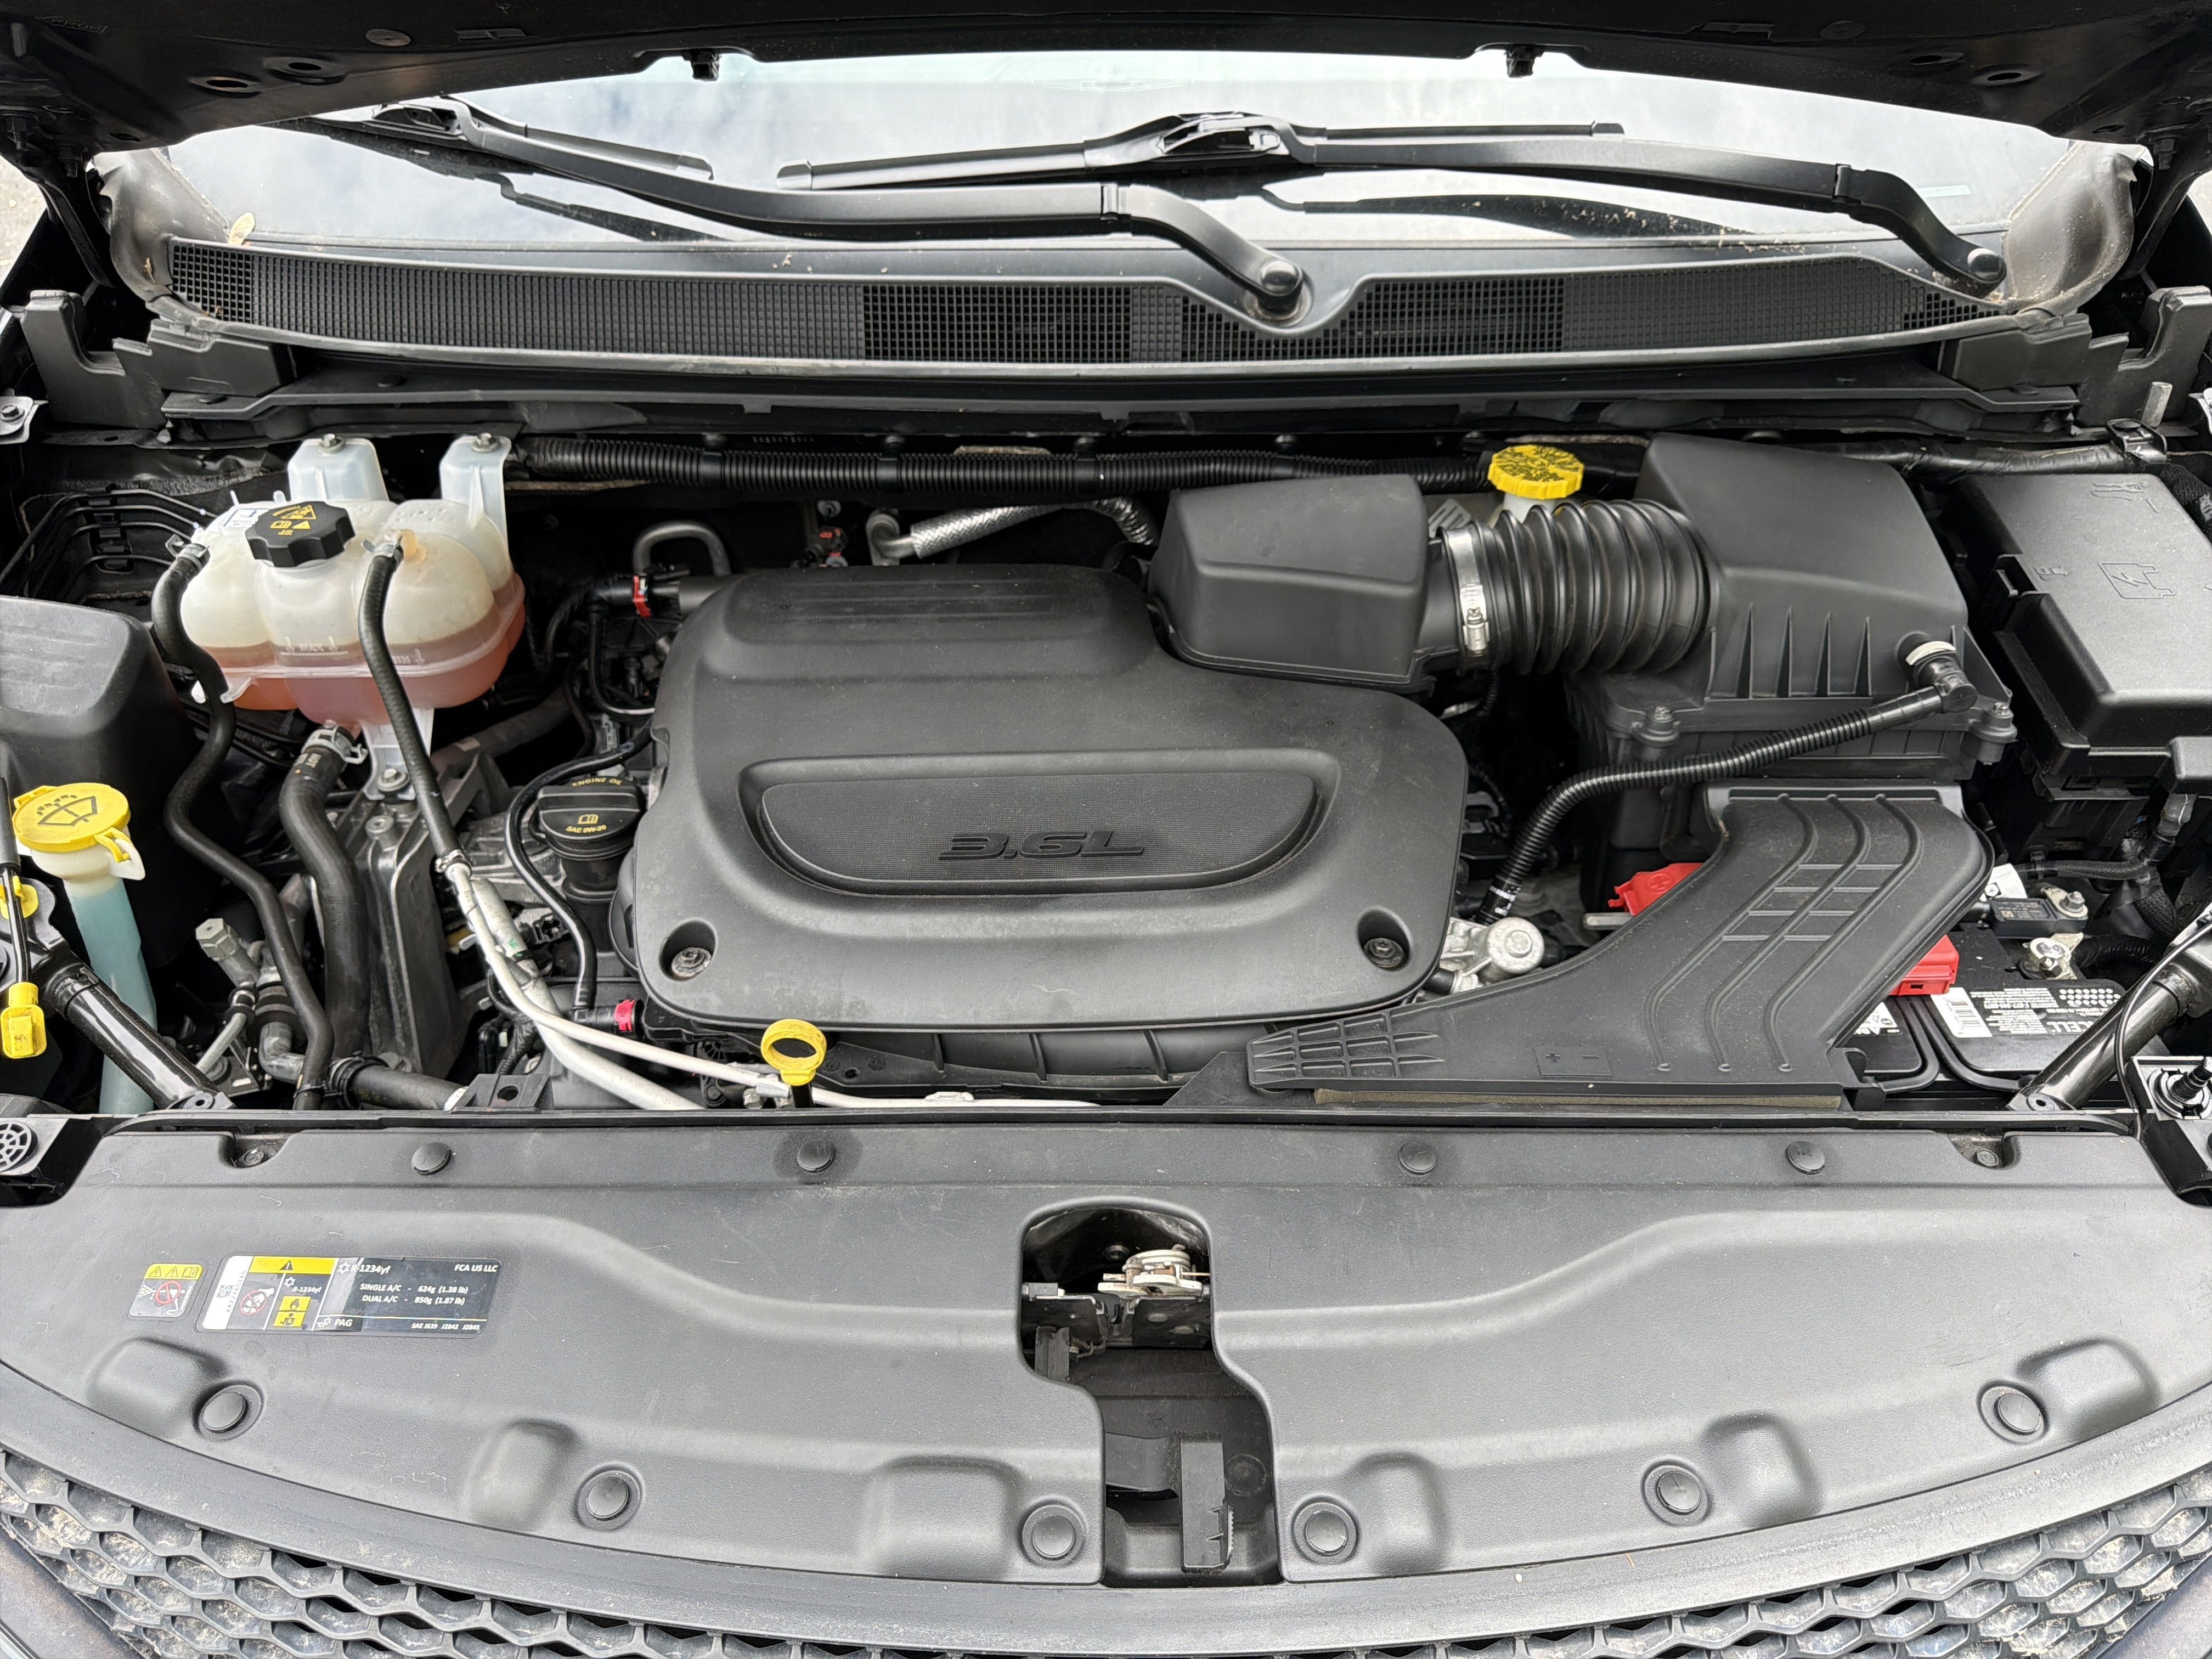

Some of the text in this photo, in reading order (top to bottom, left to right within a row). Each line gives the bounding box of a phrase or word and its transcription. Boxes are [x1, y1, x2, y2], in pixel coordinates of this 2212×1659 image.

[571, 777, 607, 787] ENGINE
[583, 824, 607, 833] 0W-20
[938, 830, 1143, 860] 3.6L
[2046, 1021, 2094, 1033] CELL
[350, 1265, 391, 1275] R-1234yf
[292, 1286, 323, 1294] R-1234yf
[359, 1283, 387, 1291] SINGLE
[386, 1284, 402, 1292] A/C
[417, 1285, 436, 1294] 624g
[438, 1285, 458, 1294] (1.38
[458, 1286, 469, 1294] lb)
[414, 1296, 433, 1305] 850g
[435, 1297, 454, 1305] (1.87
[454, 1297, 465, 1306] lb)
[334, 1319, 353, 1327] PAG
